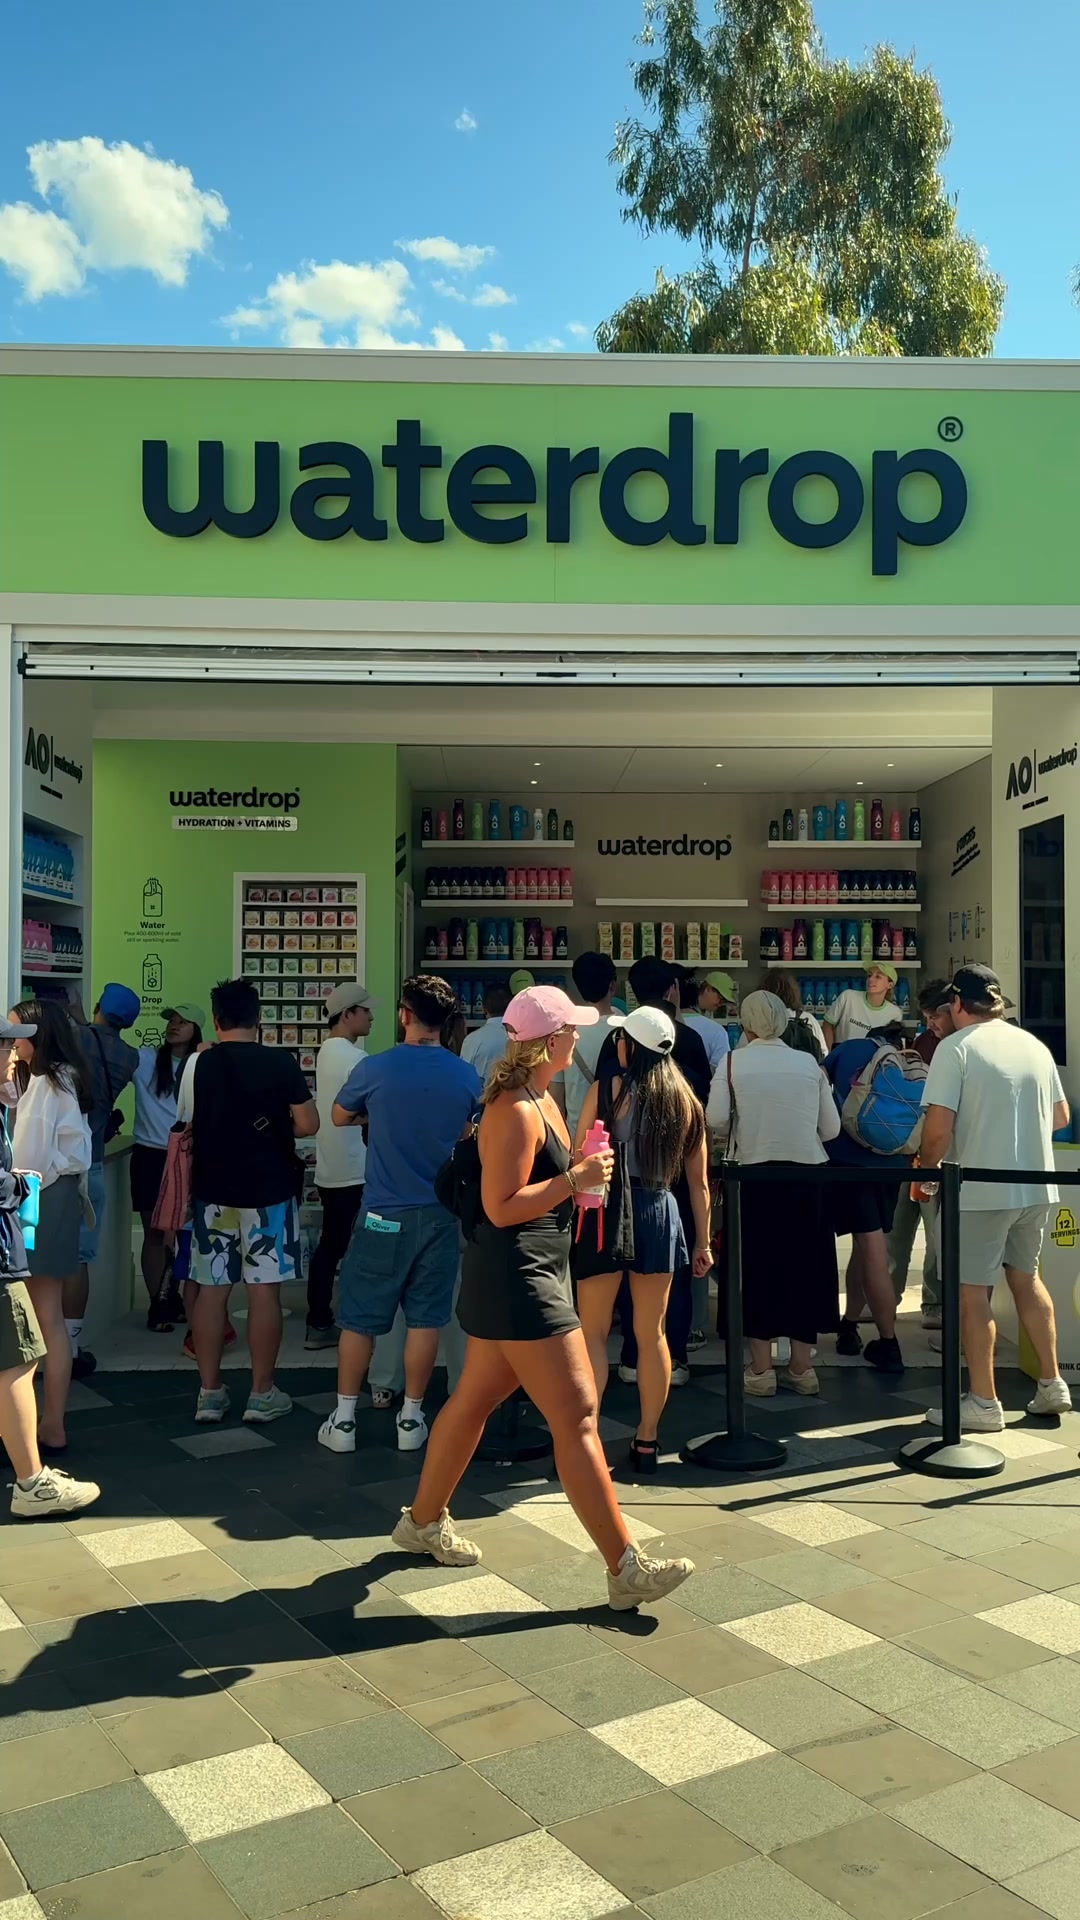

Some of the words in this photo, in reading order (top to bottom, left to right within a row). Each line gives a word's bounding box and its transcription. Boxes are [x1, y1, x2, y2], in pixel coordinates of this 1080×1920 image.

[178, 819, 234, 827] HYDRATION
[244, 819, 291, 828] VITAMINS
[142, 996, 162, 1004] Drop
[1059, 1220, 1070, 1229] 12
[1050, 1228, 1080, 1239] SERVINGS
